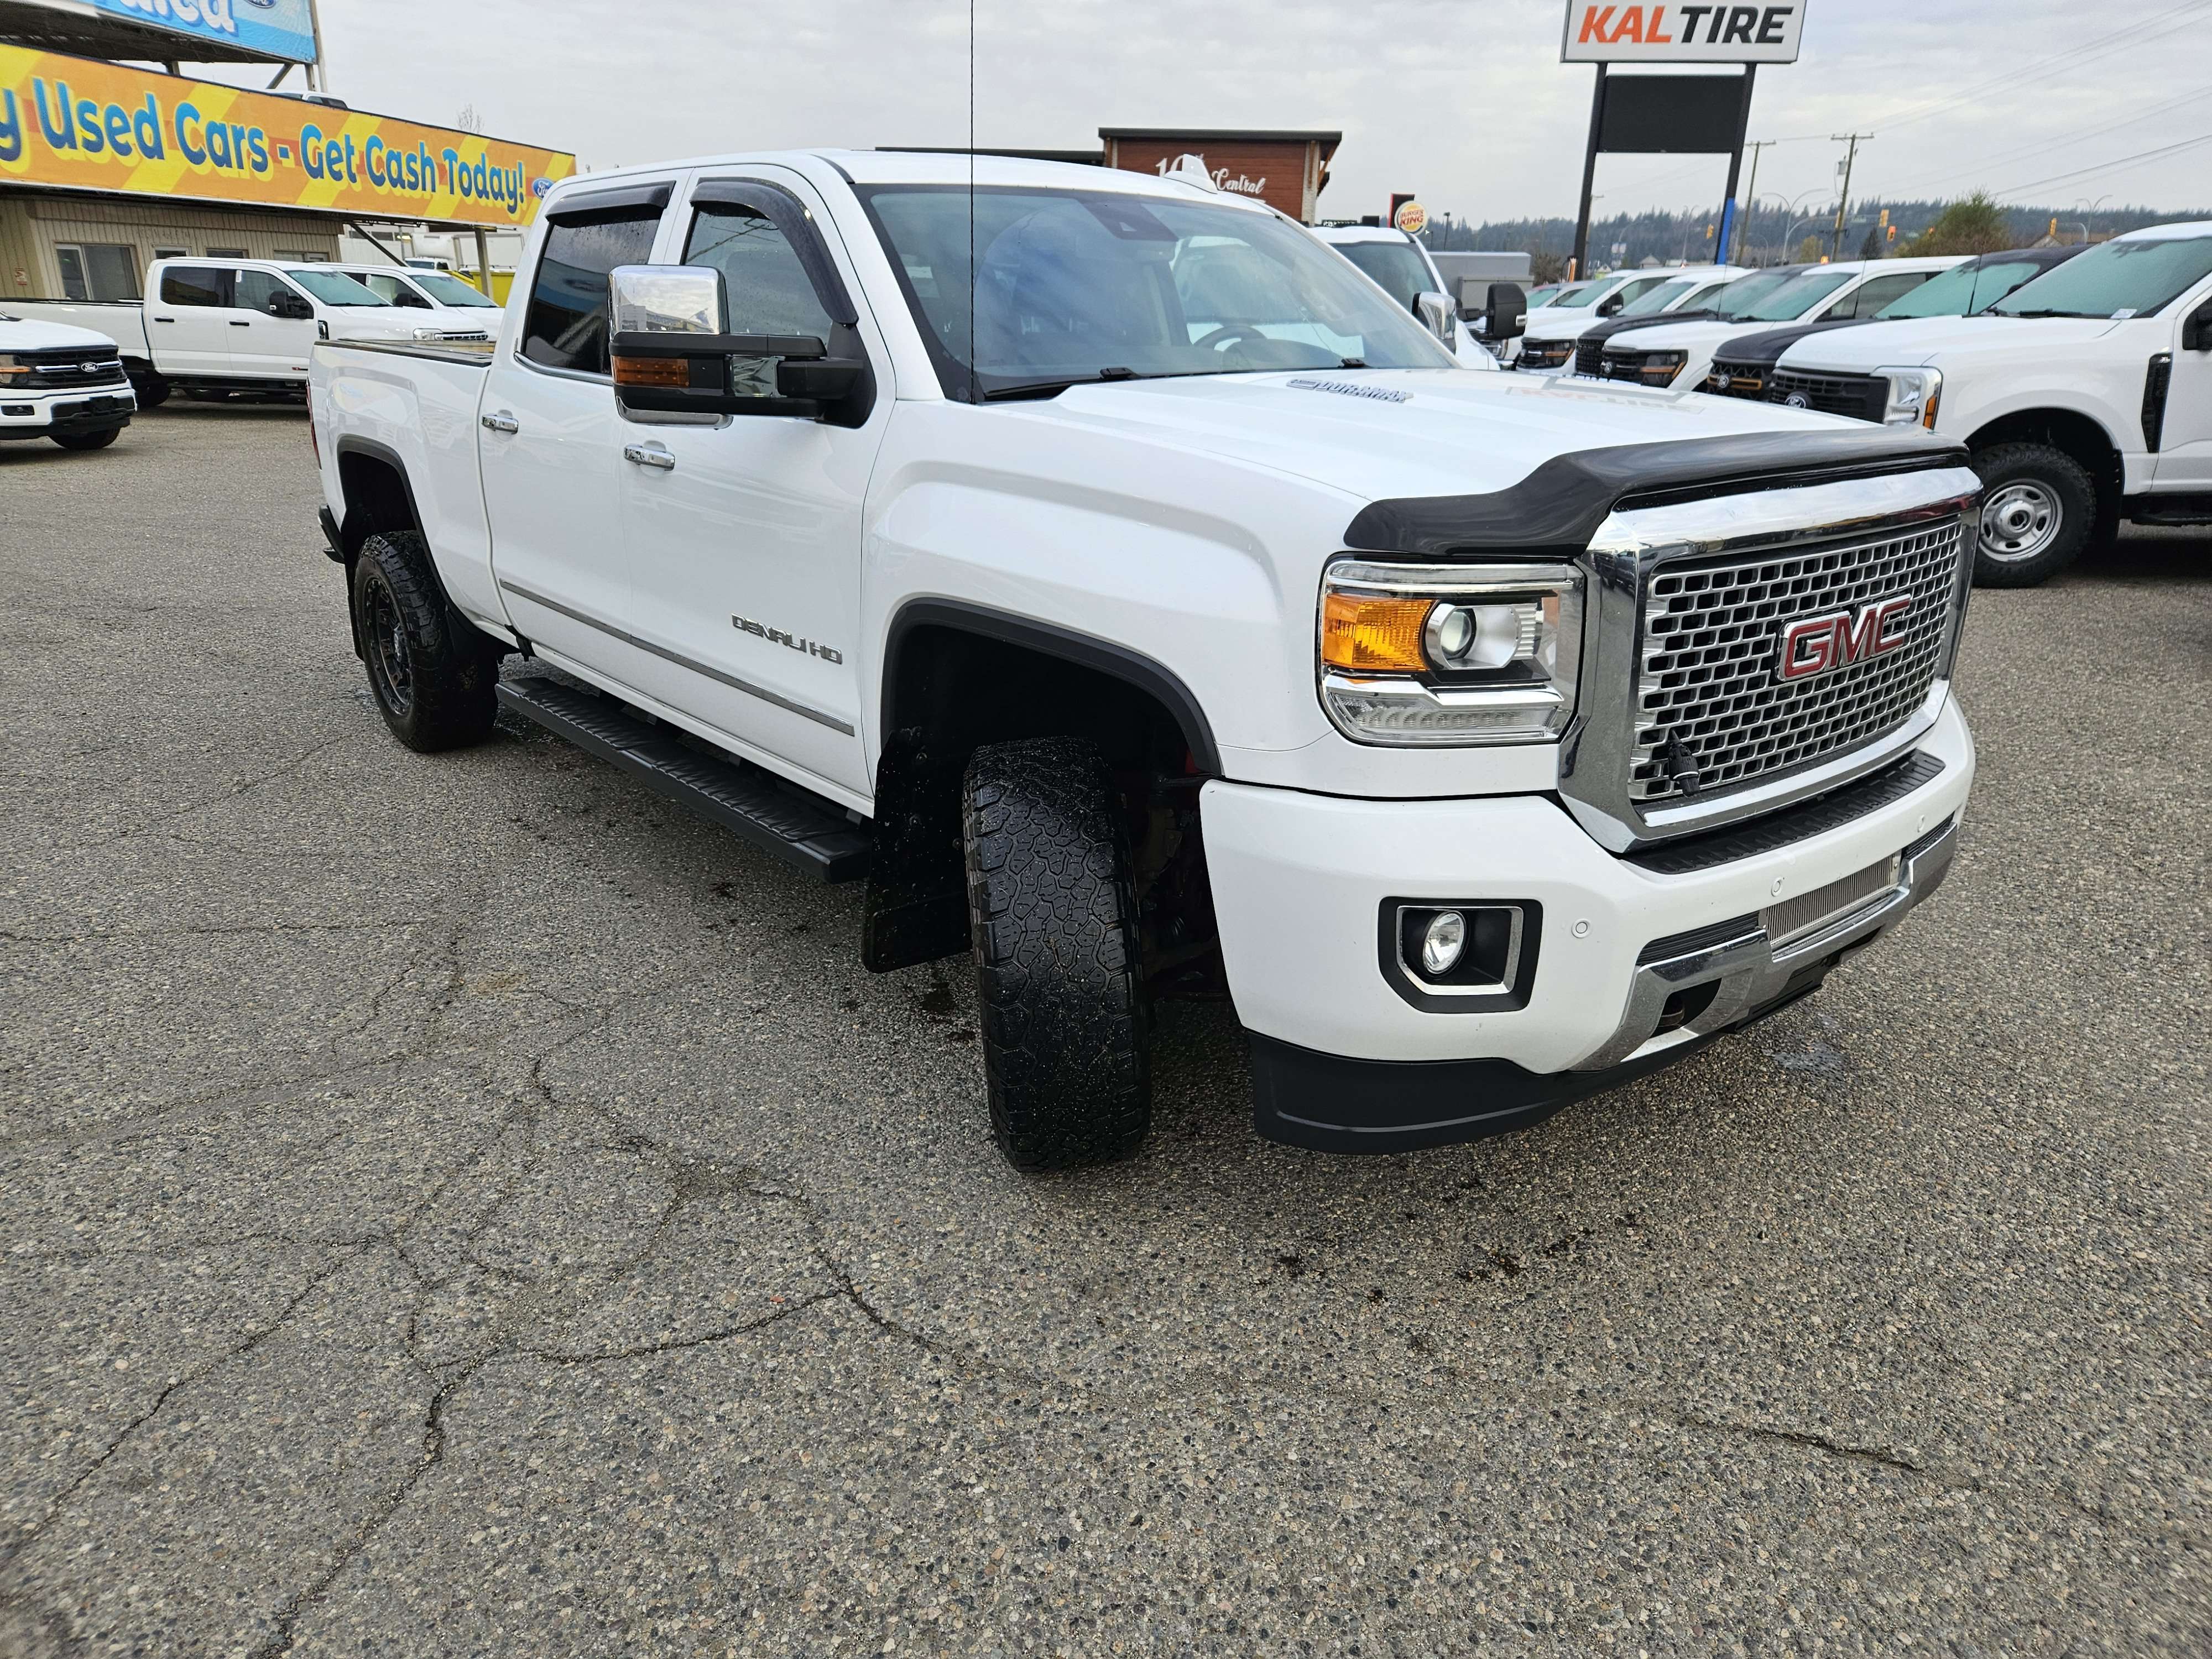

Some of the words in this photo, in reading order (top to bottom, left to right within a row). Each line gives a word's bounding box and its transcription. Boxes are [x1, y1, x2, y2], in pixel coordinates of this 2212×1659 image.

[1578, 6, 1672, 44] KAL
[1680, 6, 1794, 44] TIRE
[33, 77, 165, 160] Used
[174, 102, 269, 173] Cars
[300, 124, 357, 184] Get
[365, 135, 437, 193] Cash
[442, 147, 525, 215] Today!
[1212, 168, 1266, 194] Central
[1400, 216, 1423, 226] KING
[731, 613, 807, 653] DENALI
[809, 640, 843, 665] HD
[1777, 593, 1911, 681] GMC
